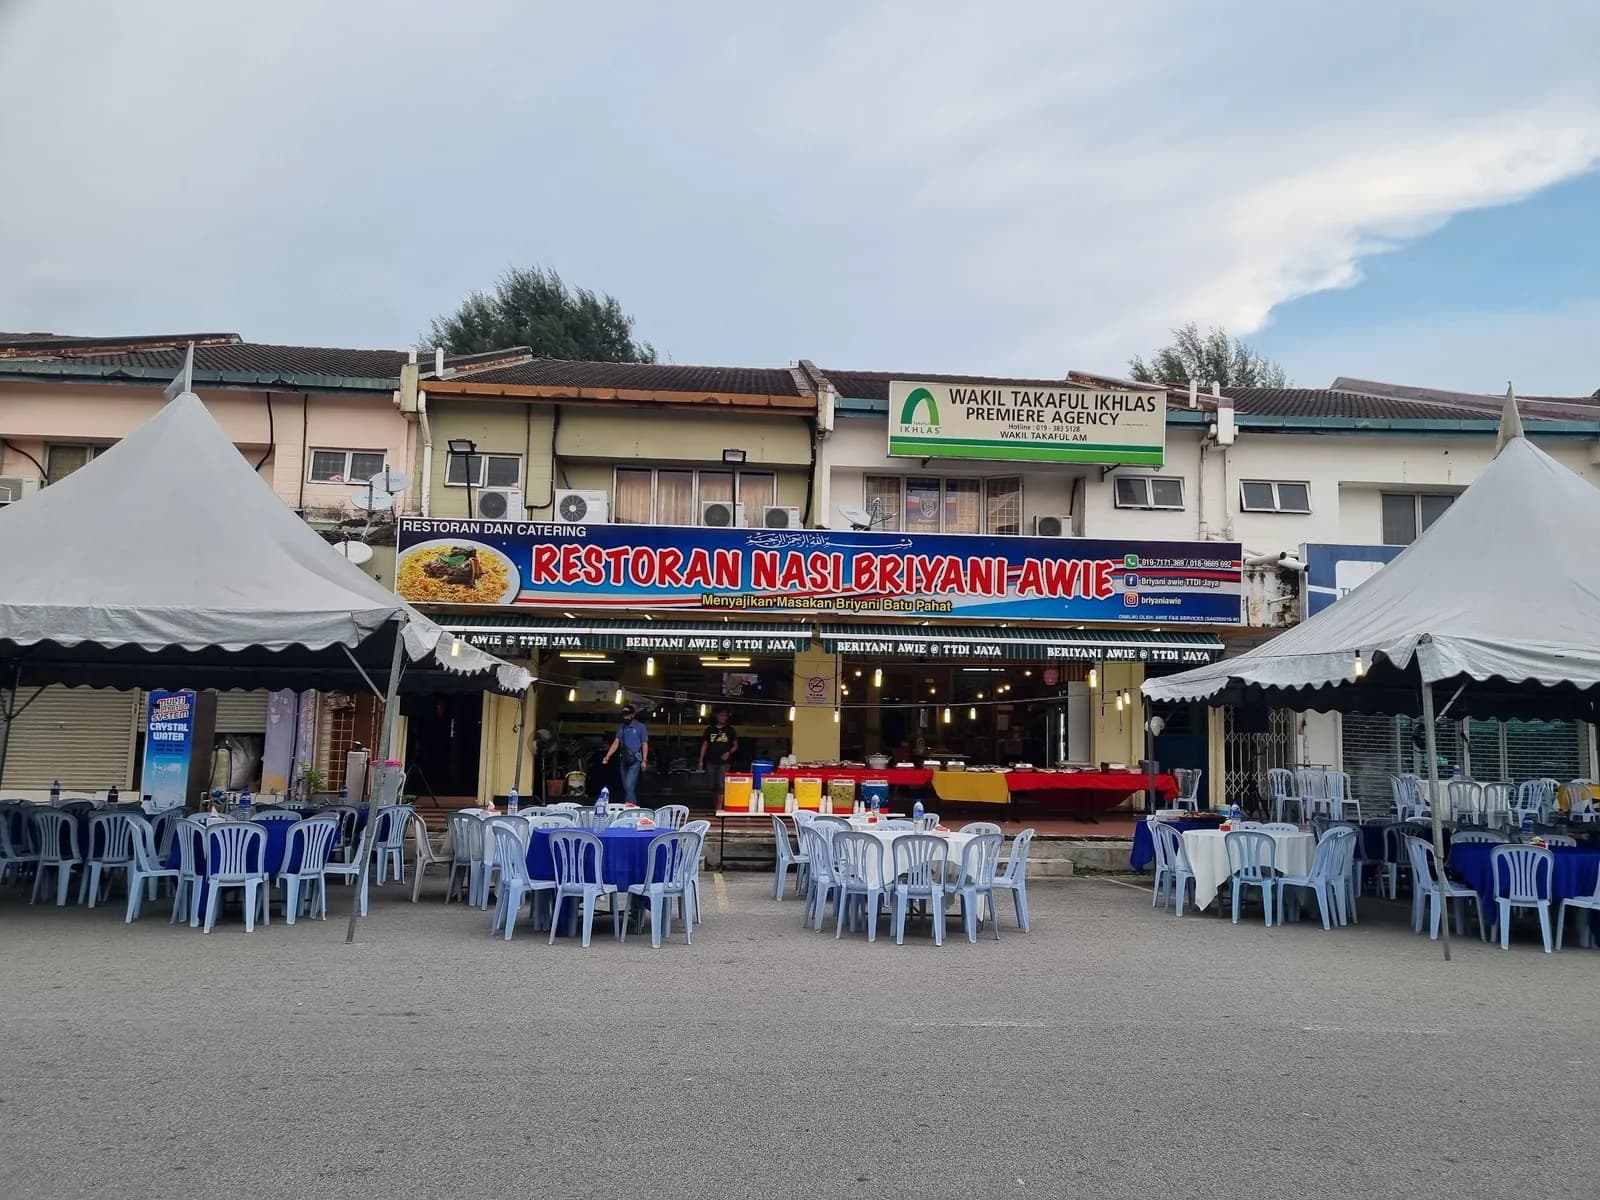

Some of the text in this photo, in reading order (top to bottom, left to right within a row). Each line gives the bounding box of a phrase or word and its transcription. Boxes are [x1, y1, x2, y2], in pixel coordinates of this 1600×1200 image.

[950, 388, 1156, 413] WAKIL TAKAFUL IKHLAS
[966, 407, 1120, 426] PREMIERE AGENCY
[900, 425, 940, 434] IKHLAS
[1008, 423, 1031, 431] Hotline
[1000, 431, 1087, 442] WAKIL TAKAFUL AM
[402, 521, 587, 537] RESTORAN DAN CATERING
[531, 544, 1116, 600] RESTORAN NASI BRIYANI AWIE
[1141, 577, 1166, 587] Briyani
[1186, 578, 1202, 586] TTDI
[1203, 580, 1219, 588] Jaya
[702, 594, 952, 612] Menyajikan Masakan Briyani Batu Pahat
[470, 635, 502, 645] AWIE
[519, 635, 548, 646] TTDI
[551, 637, 581, 646] JAYA
[626, 637, 796, 650] BERIYANI AWIE @ TTDI JAYA
[837, 641, 1002, 656] BERIYANI AWIE @ TTDI JAYA
[1047, 647, 1210, 661] BERIYANI AWIE @ TTDI JAYA
[150, 722, 189, 732] CRYSTAL
[153, 732, 185, 741] WATER
